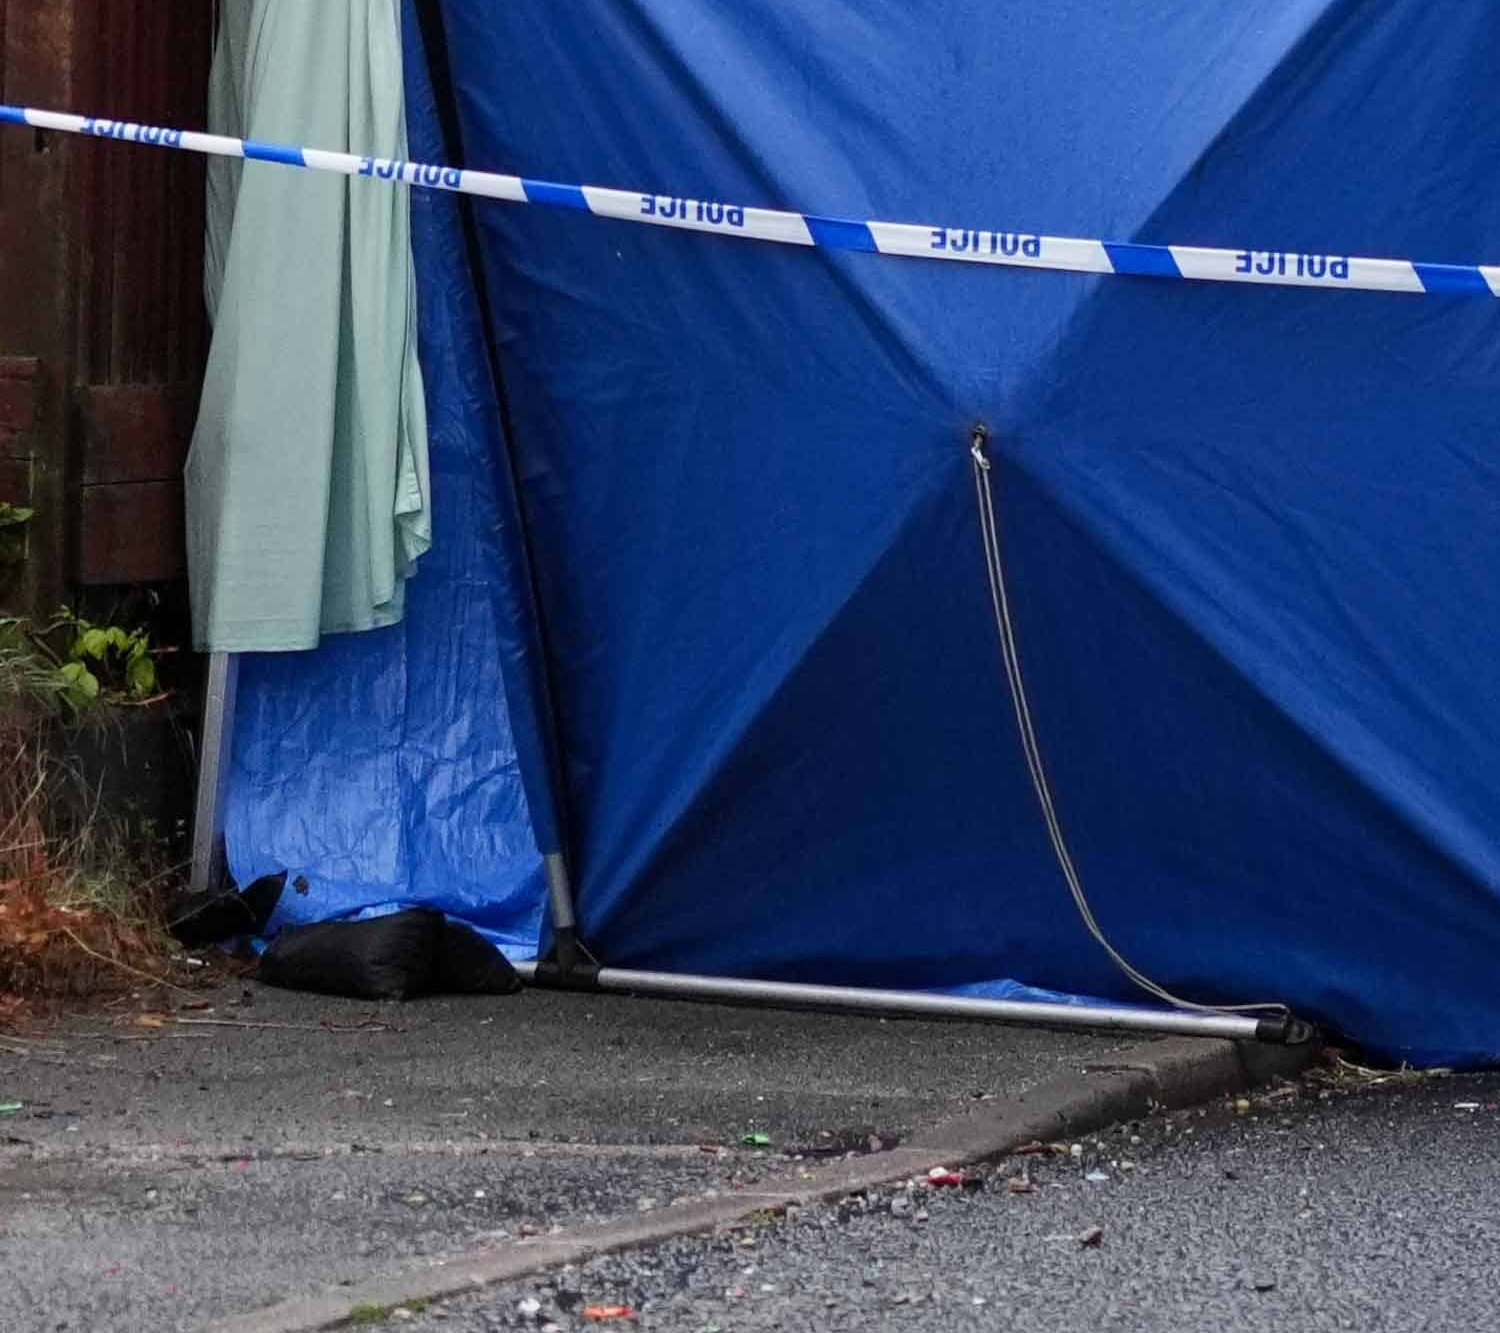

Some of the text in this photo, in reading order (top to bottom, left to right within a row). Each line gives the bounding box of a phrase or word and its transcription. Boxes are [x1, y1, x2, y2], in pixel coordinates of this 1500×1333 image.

[641, 194, 745, 227] POLICE
[930, 227, 1041, 258] POLICE
[1236, 250, 1349, 280] POLICE
